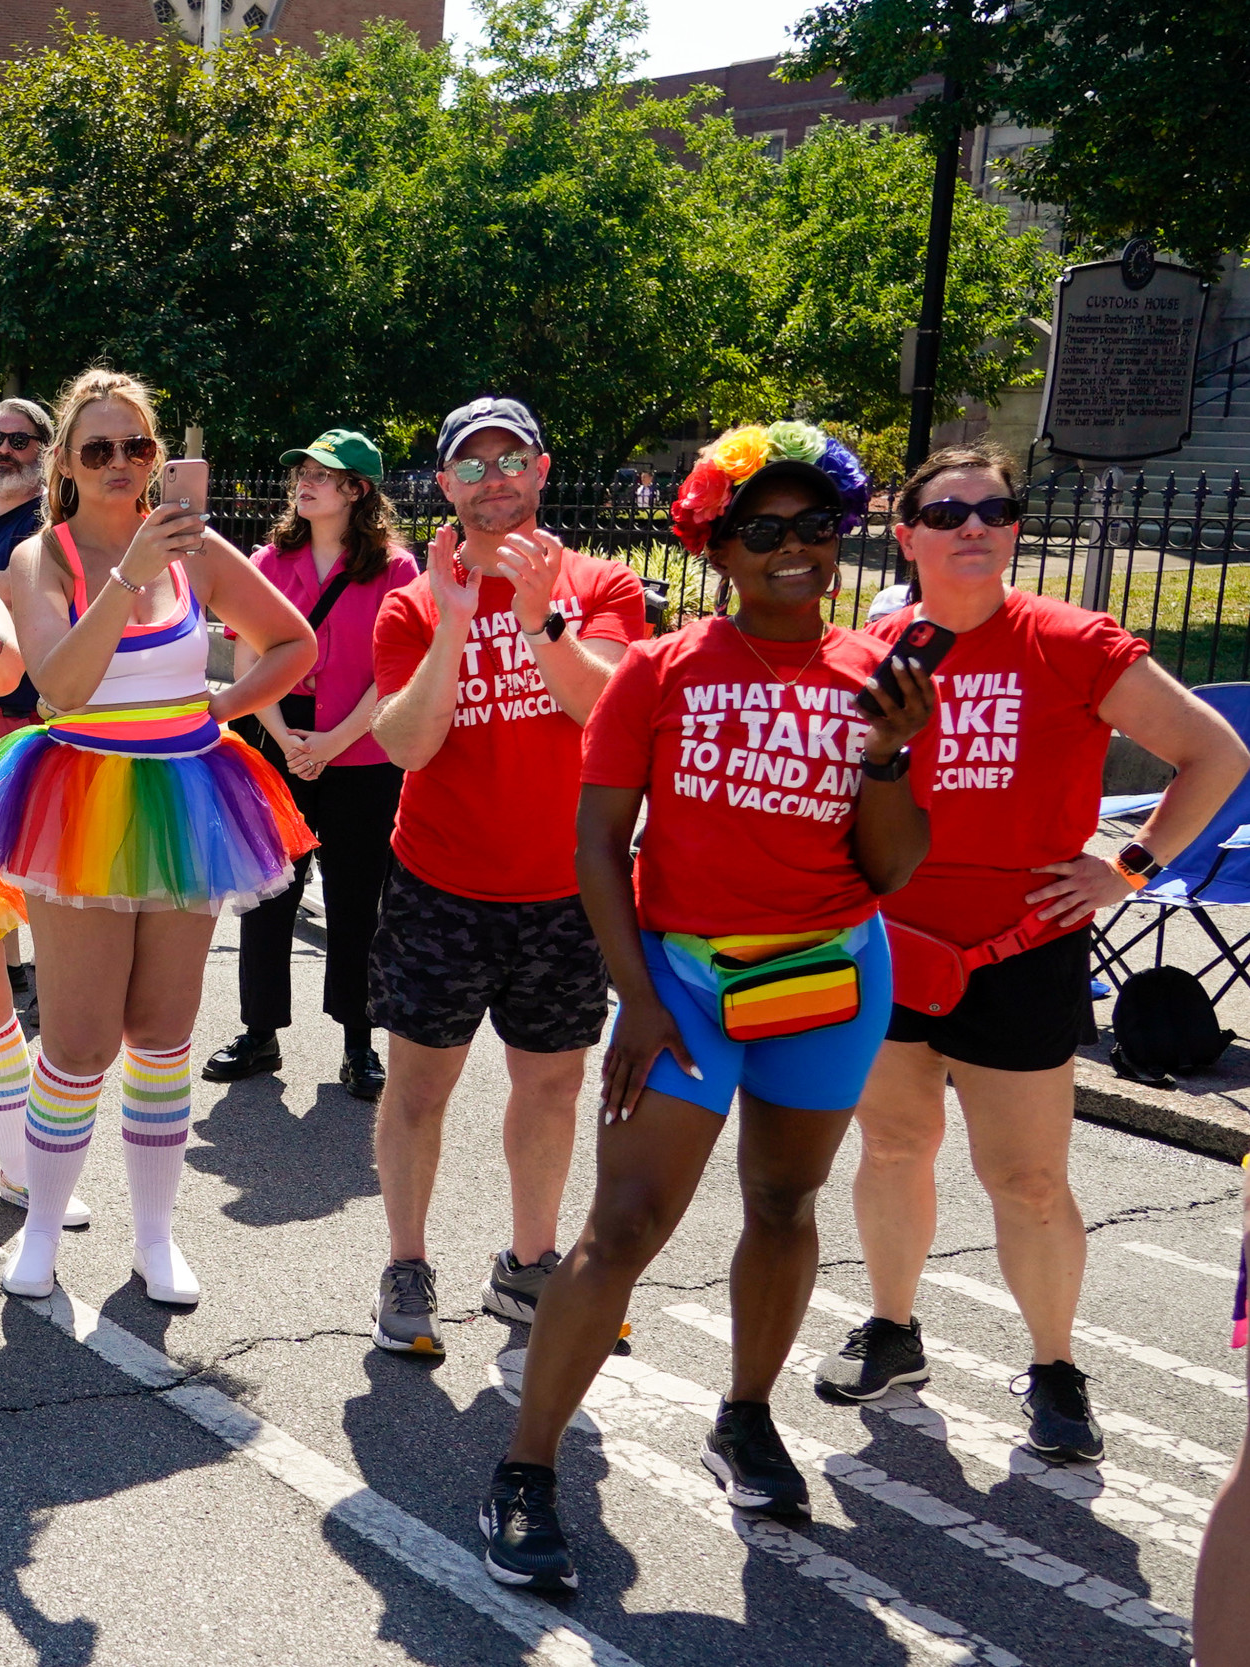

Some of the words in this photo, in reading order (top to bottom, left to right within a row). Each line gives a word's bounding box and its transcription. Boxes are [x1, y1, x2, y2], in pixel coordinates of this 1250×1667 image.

[1086, 295, 1139, 309] CUSTOMS
[1144, 297, 1180, 310] HOUSE
[1066, 313, 1101, 323] President
[1104, 314, 1144, 325] Rutherford
[1156, 315, 1177, 327] Hayes
[1077, 326, 1119, 335] cornerstone
[1065, 334, 1098, 345] Treasury
[1099, 335, 1140, 346] Department
[1062, 355, 1097, 364] collectors
[1101, 356, 1110, 365] of
[1057, 386, 1080, 397] began
[1060, 377, 1077, 386] main
[1079, 377, 1096, 388] post
[1128, 376, 1158, 386] Addition
[1160, 377, 1168, 386] to
[1057, 397, 1083, 408] surplus
[1155, 397, 1166, 406] the
[1078, 407, 1113, 417] renovated
[1114, 407, 1125, 418] by
[1127, 407, 1139, 416] the
[1139, 407, 1181, 418] development
[1054, 417, 1071, 427] firm
[1075, 417, 1089, 426] that
[470, 610, 518, 639] HAT
[549, 596, 583, 619] ILL
[463, 642, 482, 676] T
[457, 677, 488, 704] TO
[494, 668, 546, 698] FIND
[953, 672, 1023, 699] WILL
[454, 703, 493, 728] HIV
[498, 694, 564, 722] VACCI
[683, 683, 786, 713] WHAT
[795, 685, 864, 720] WIL
[941, 698, 1021, 735] KE
[682, 712, 726, 740] IT
[740, 710, 871, 764] TAKE
[966, 736, 1017, 763] AN
[680, 739, 720, 772] TO
[725, 748, 808, 789] FIND
[814, 765, 863, 797] AN
[932, 766, 1014, 792] CINE?
[674, 772, 719, 802] HIV
[726, 782, 851, 825] VACCINE?
